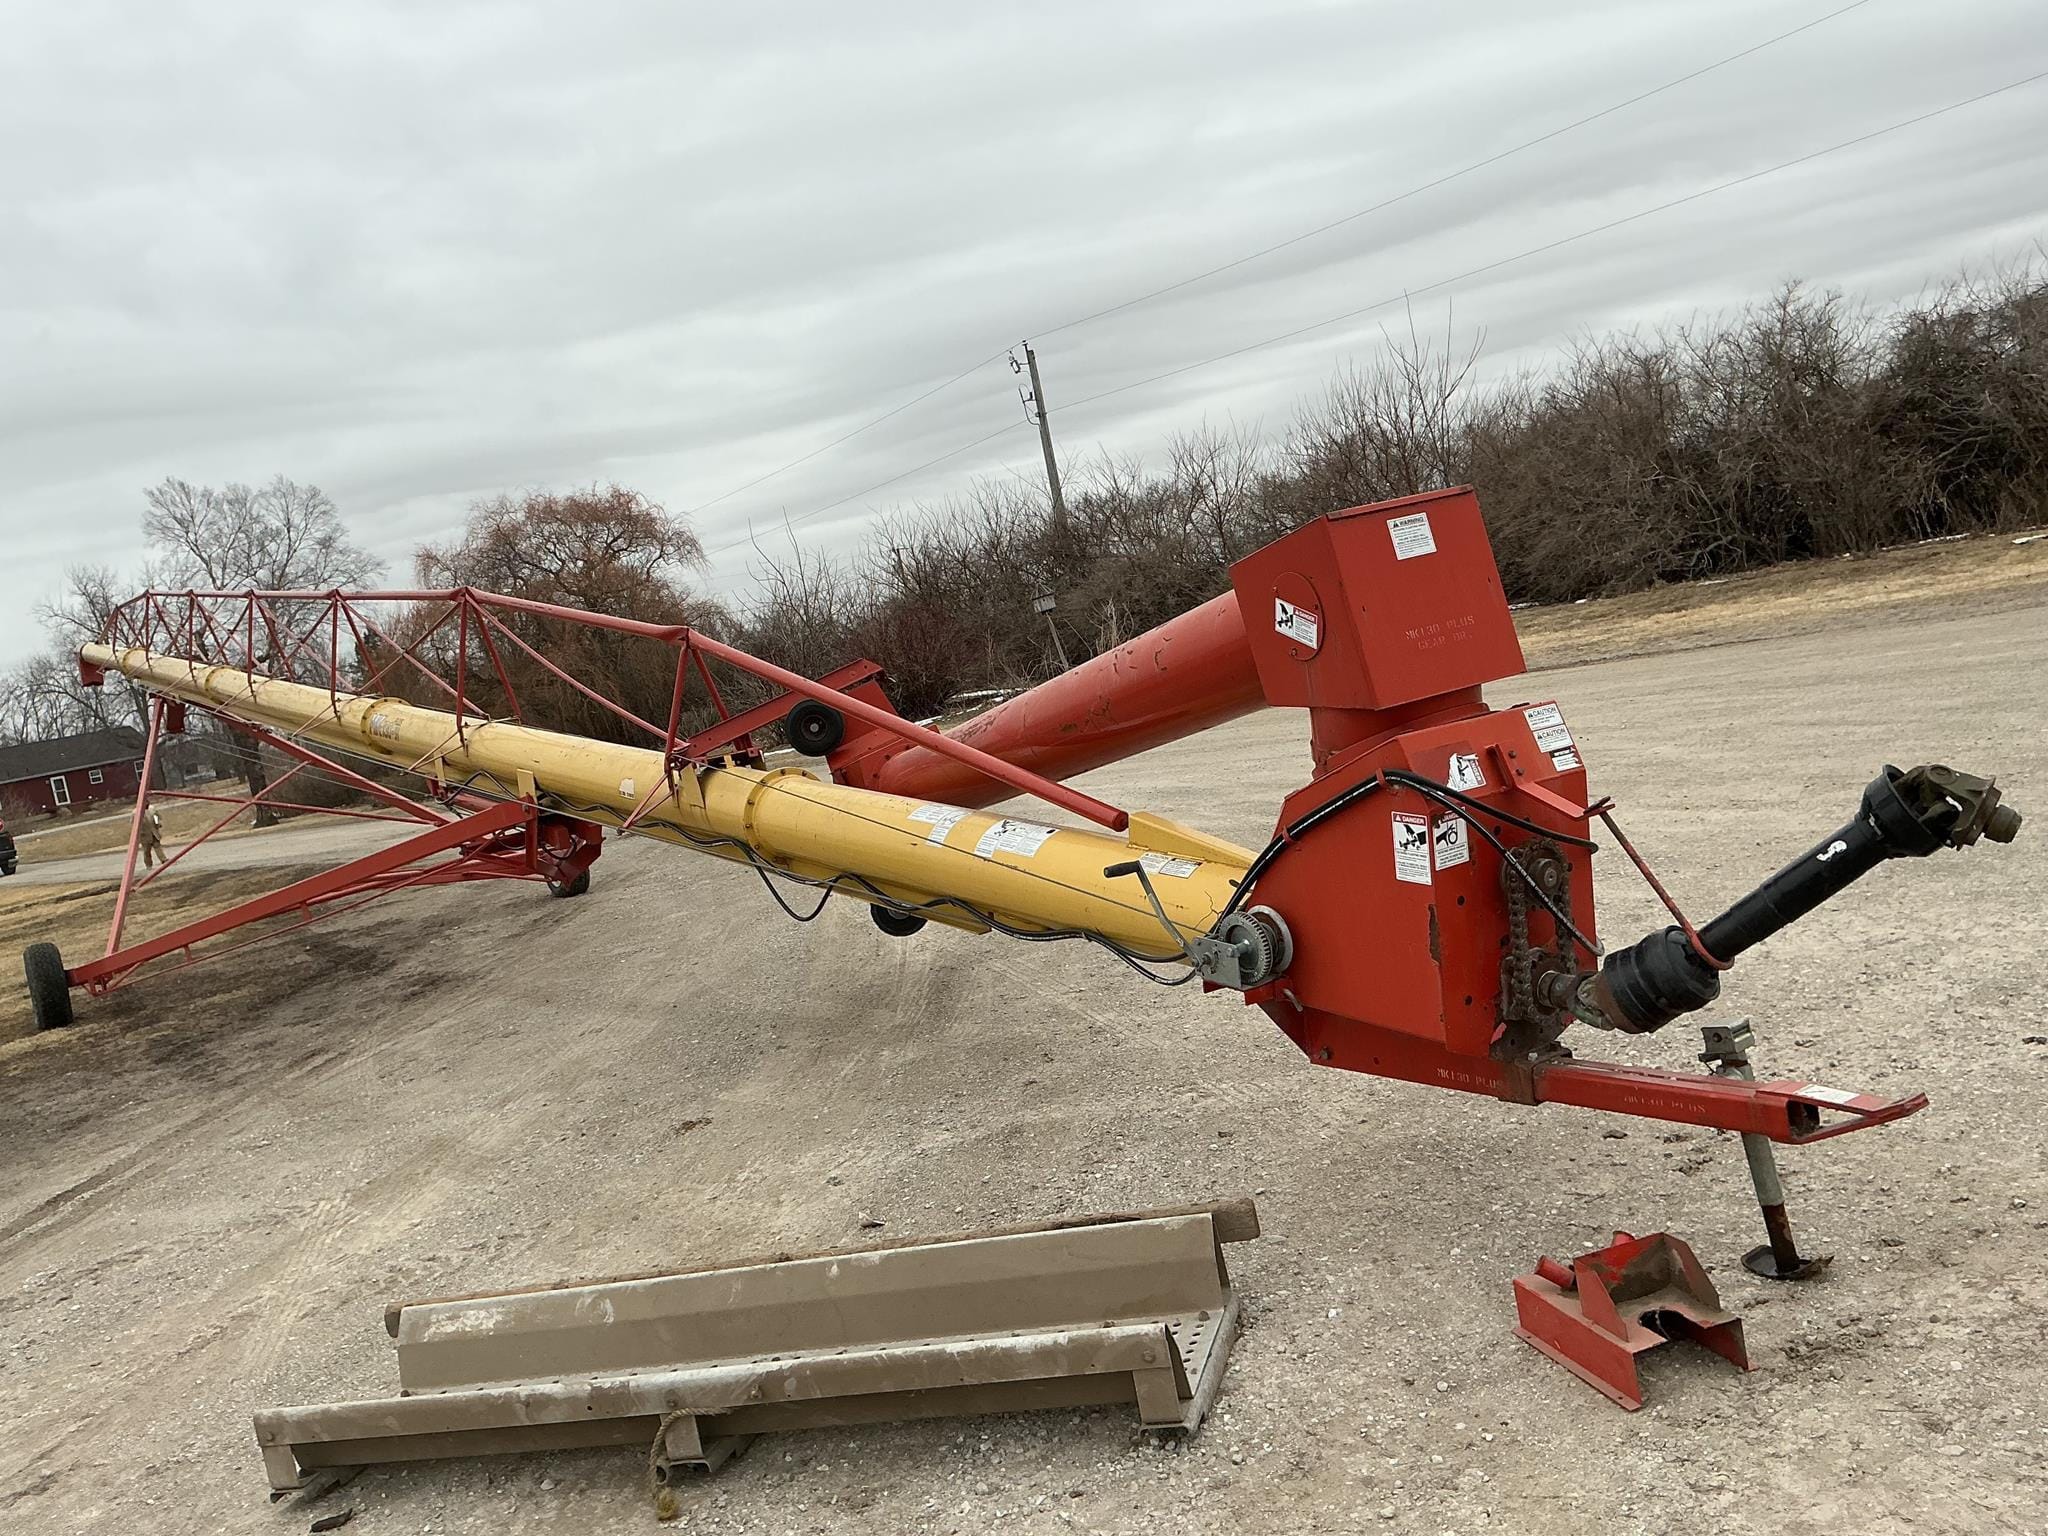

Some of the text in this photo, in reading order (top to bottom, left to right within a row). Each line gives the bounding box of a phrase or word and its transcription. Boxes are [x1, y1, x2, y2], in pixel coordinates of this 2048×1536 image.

[1399, 516, 1424, 526] WARNING
[1298, 611, 1315, 621] DANGER
[1446, 615, 1475, 629] PLUS
[1418, 635, 1446, 649] GEAR
[1532, 706, 1556, 717] CAUTION
[1542, 727, 1566, 739] CAUTION
[1470, 760, 1484, 784] ANGER
[1401, 815, 1425, 825] DANGER
[1436, 1067, 1470, 1083] MK130
